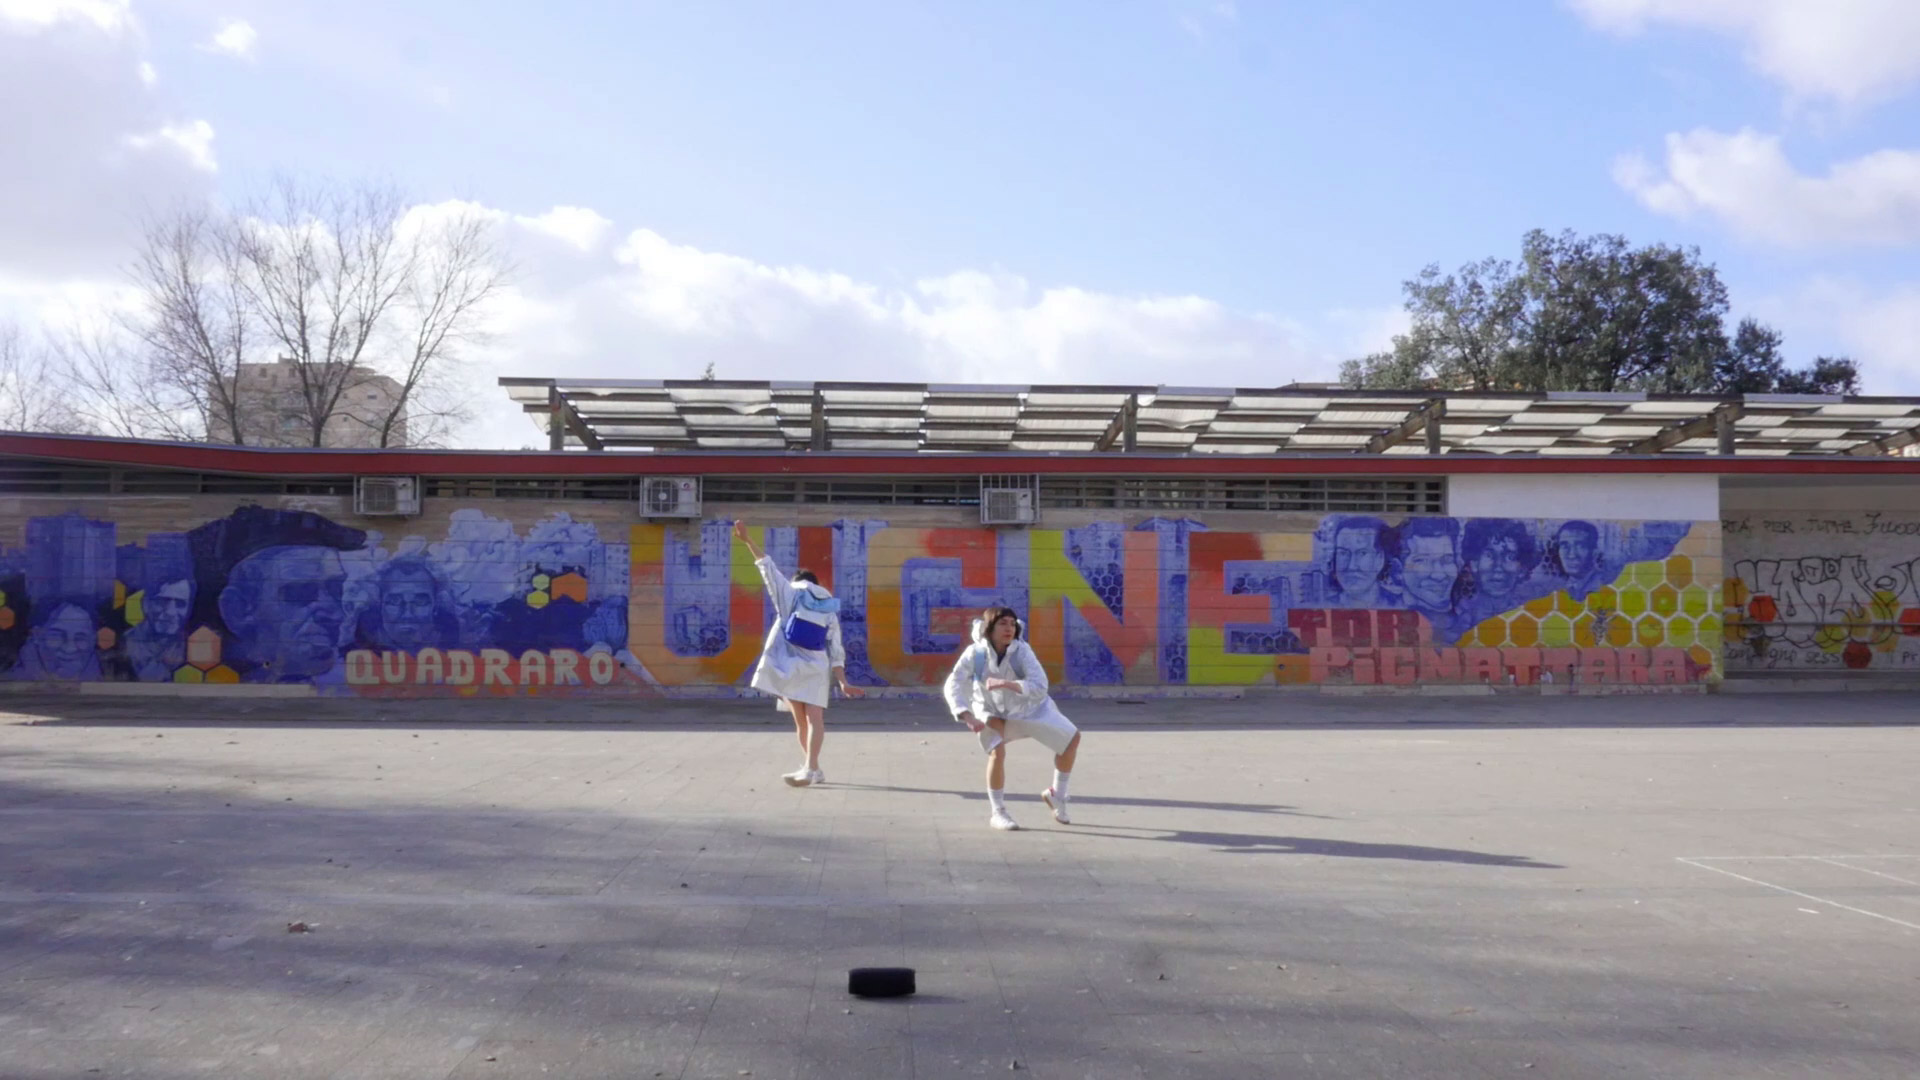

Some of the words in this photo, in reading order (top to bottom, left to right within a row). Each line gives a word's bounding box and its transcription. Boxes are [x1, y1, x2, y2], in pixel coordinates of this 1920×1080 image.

[1763, 519, 1795, 534] PER
[1288, 609, 1420, 648] TOR
[345, 648, 614, 685] QUADRARO
